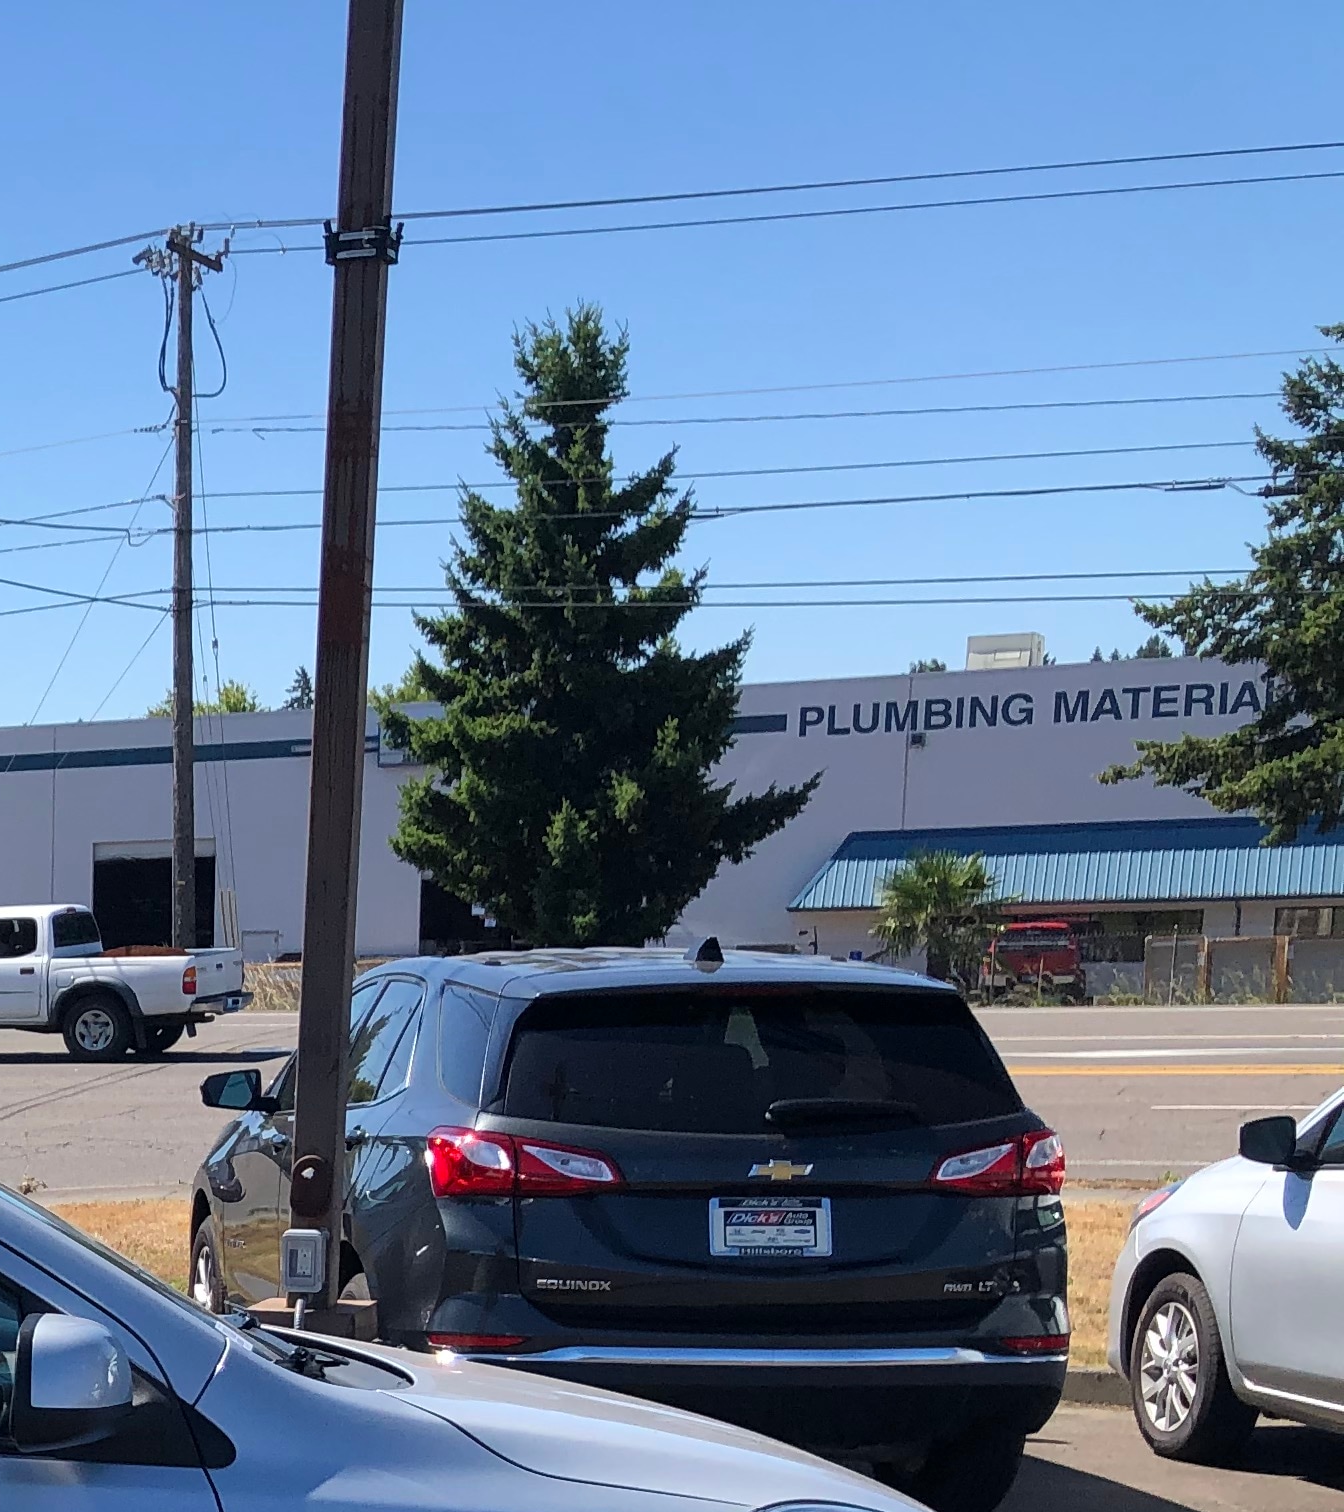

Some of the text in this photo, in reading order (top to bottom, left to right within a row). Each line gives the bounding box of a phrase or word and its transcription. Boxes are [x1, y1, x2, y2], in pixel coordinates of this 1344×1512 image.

[798, 693, 1035, 738] PLUMBING
[730, 1212, 781, 1224] Dick's
[741, 1248, 803, 1256] Hillsboro
[536, 1278, 612, 1291] EQUINOX
